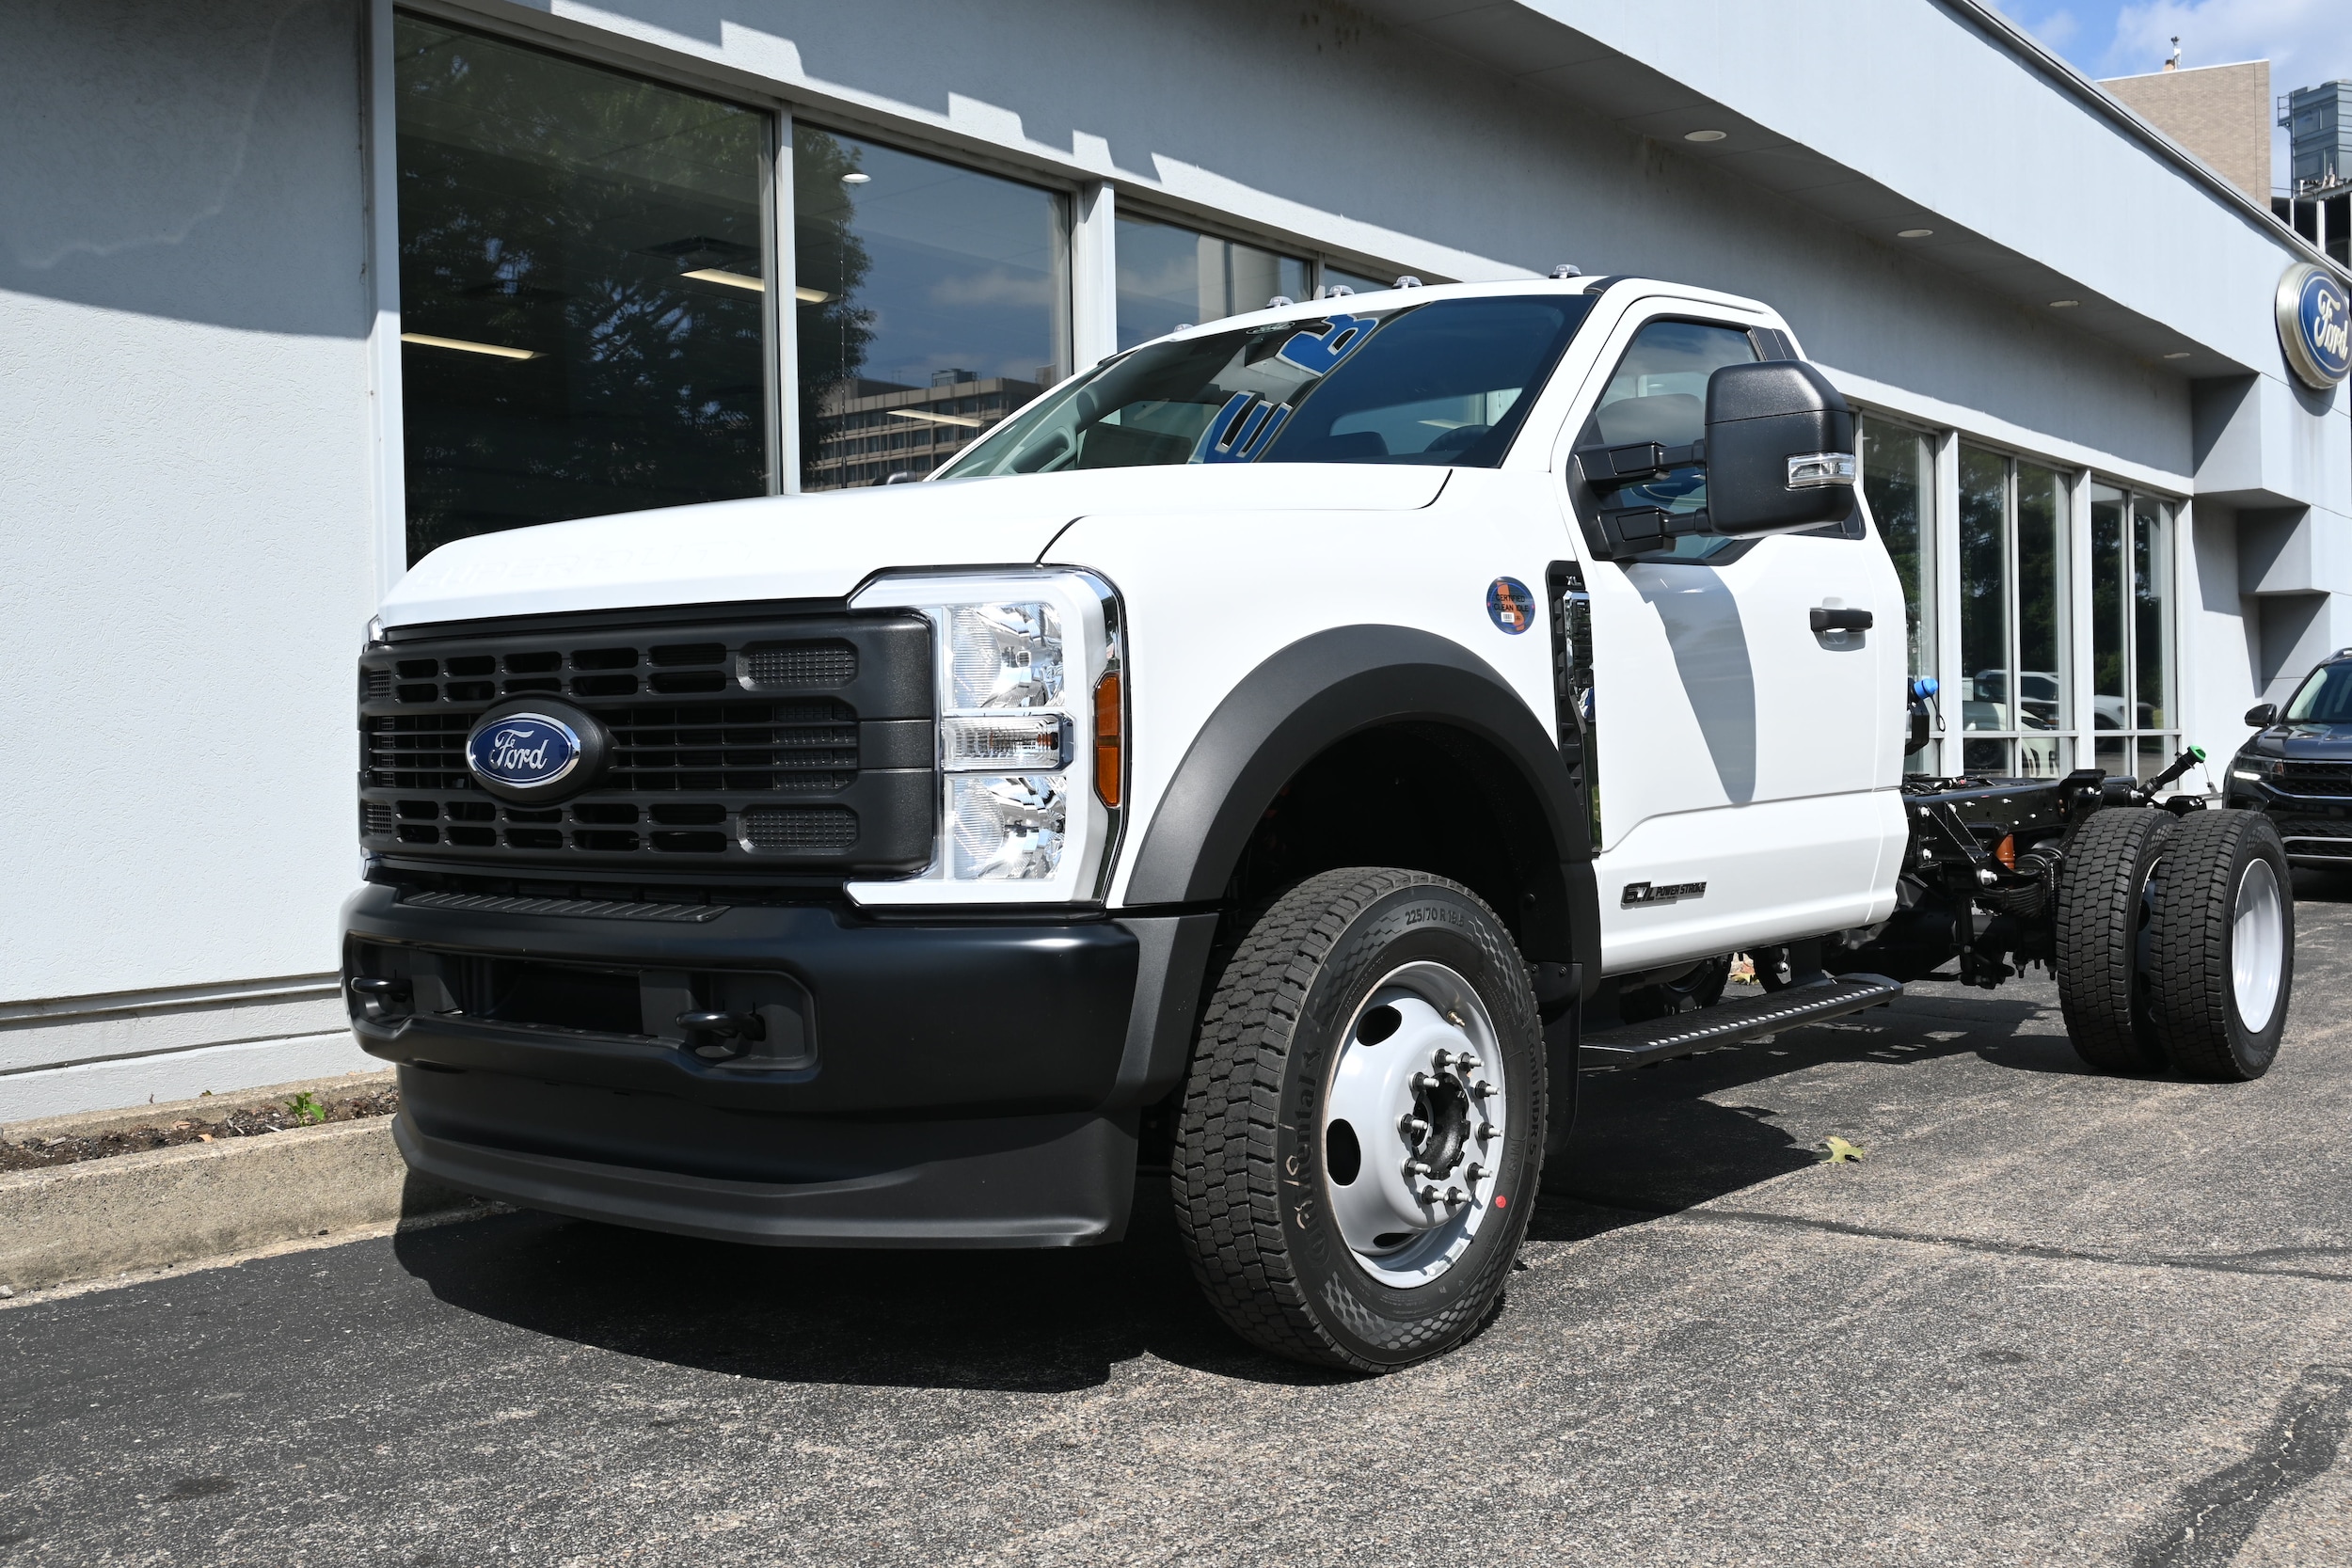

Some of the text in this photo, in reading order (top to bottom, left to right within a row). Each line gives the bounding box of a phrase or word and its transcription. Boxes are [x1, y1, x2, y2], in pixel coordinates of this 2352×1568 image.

[2314, 289, 2349, 360] Ford
[1565, 575, 1582, 586] XL
[1494, 603, 1514, 611] CLEAN
[1496, 594, 1525, 603] CERTIFIED
[488, 729, 549, 770] Ford
[1655, 885, 1679, 897] POWER
[1679, 882, 1707, 895] STROKE
[1405, 907, 1438, 926] 225/70
[1526, 1027, 1541, 1086] Conti
[1531, 1089, 1541, 1138] HDR
